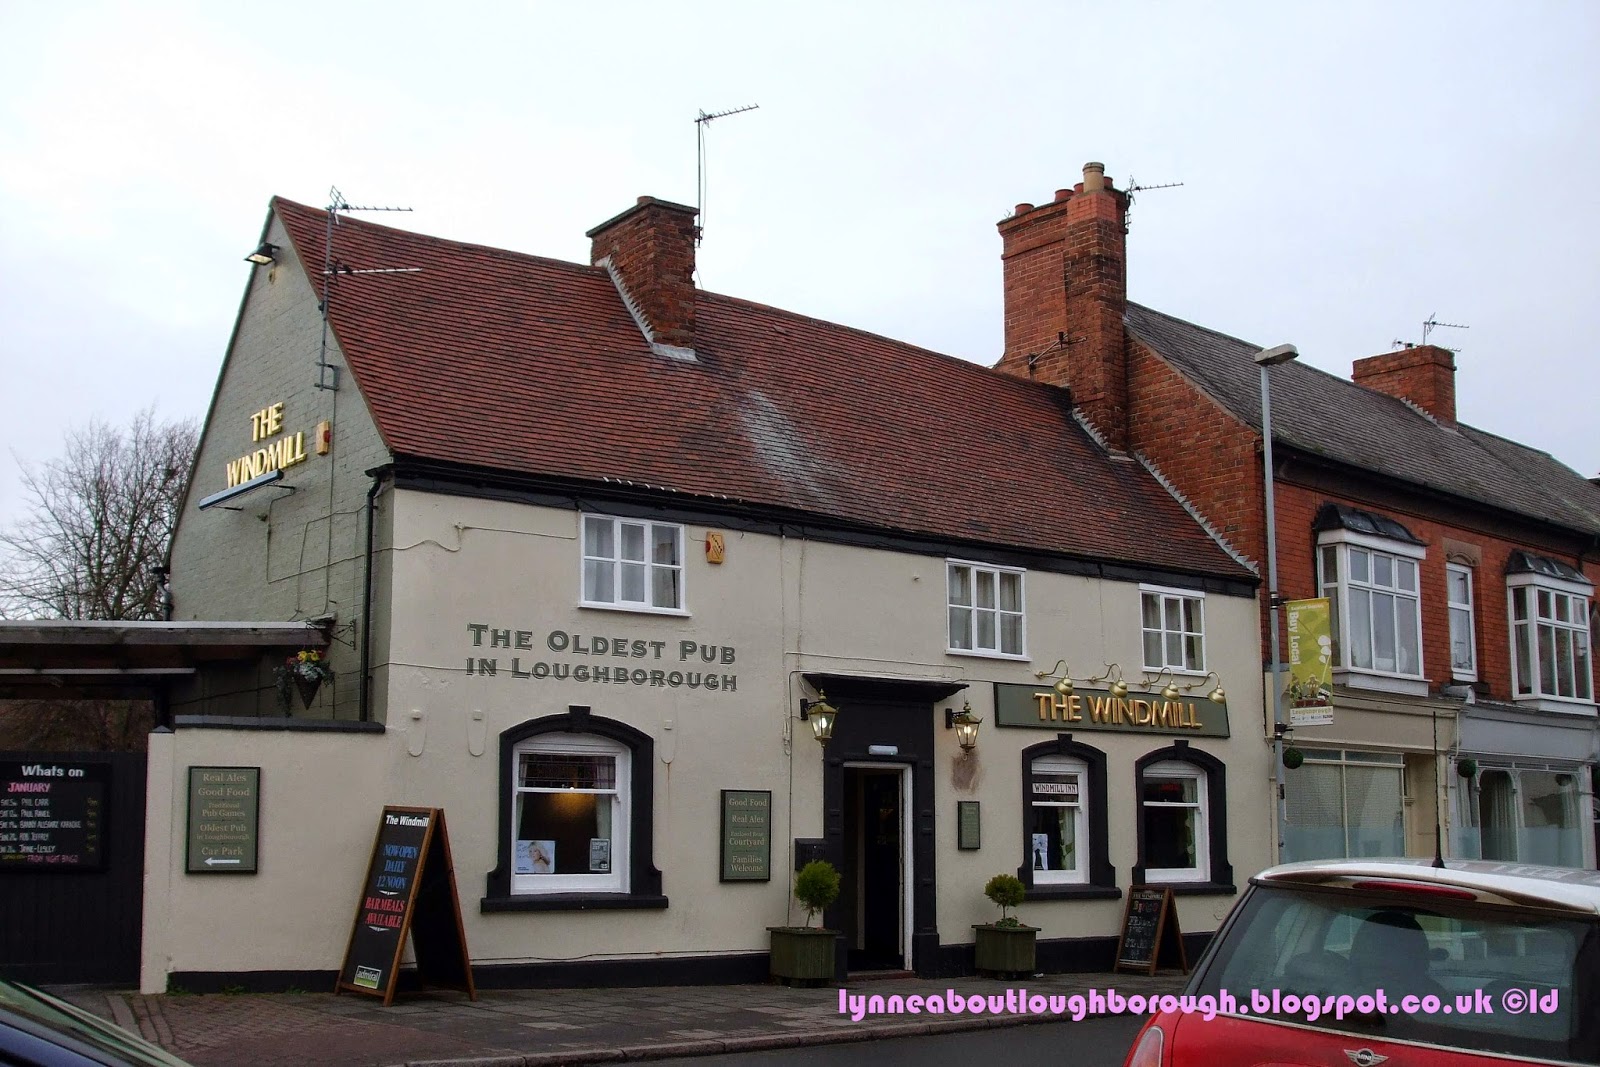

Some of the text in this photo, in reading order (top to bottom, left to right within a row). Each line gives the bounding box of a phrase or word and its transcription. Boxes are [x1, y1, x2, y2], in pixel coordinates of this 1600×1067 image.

[250, 401, 284, 442] THE
[226, 431, 307, 489] WINDMILL
[467, 623, 736, 665] THE OLDEST PUB
[1289, 611, 1301, 665] Buy Local
[466, 657, 737, 692] IN LOUGHBOROUGH
[1033, 692, 1202, 729] THE WINDMILL
[22, 765, 84, 777] Whats on
[203, 773, 247, 782] Real Ales
[8, 782, 51, 793] JANUARY
[198, 787, 250, 796] Good Food
[1035, 784, 1076, 794] WINDMILL INN
[729, 798, 767, 807] Good Food
[202, 809, 246, 817] Pub Games
[732, 815, 764, 823] Real Ales
[385, 814, 429, 827] The Windmill
[200, 824, 246, 832] Oldest Pub
[729, 838, 765, 847] Courtyard
[201, 847, 243, 856] Car Park
[384, 844, 418, 859] NOW OPEN
[732, 855, 762, 863] Families
[384, 860, 407, 873] DAILY
[730, 864, 763, 872] Welcome
[377, 875, 407, 889] 12 NOON
[365, 897, 405, 912] BAR MEALS
[365, 912, 403, 928] AVAILABLE
[356, 970, 379, 982] admiral
